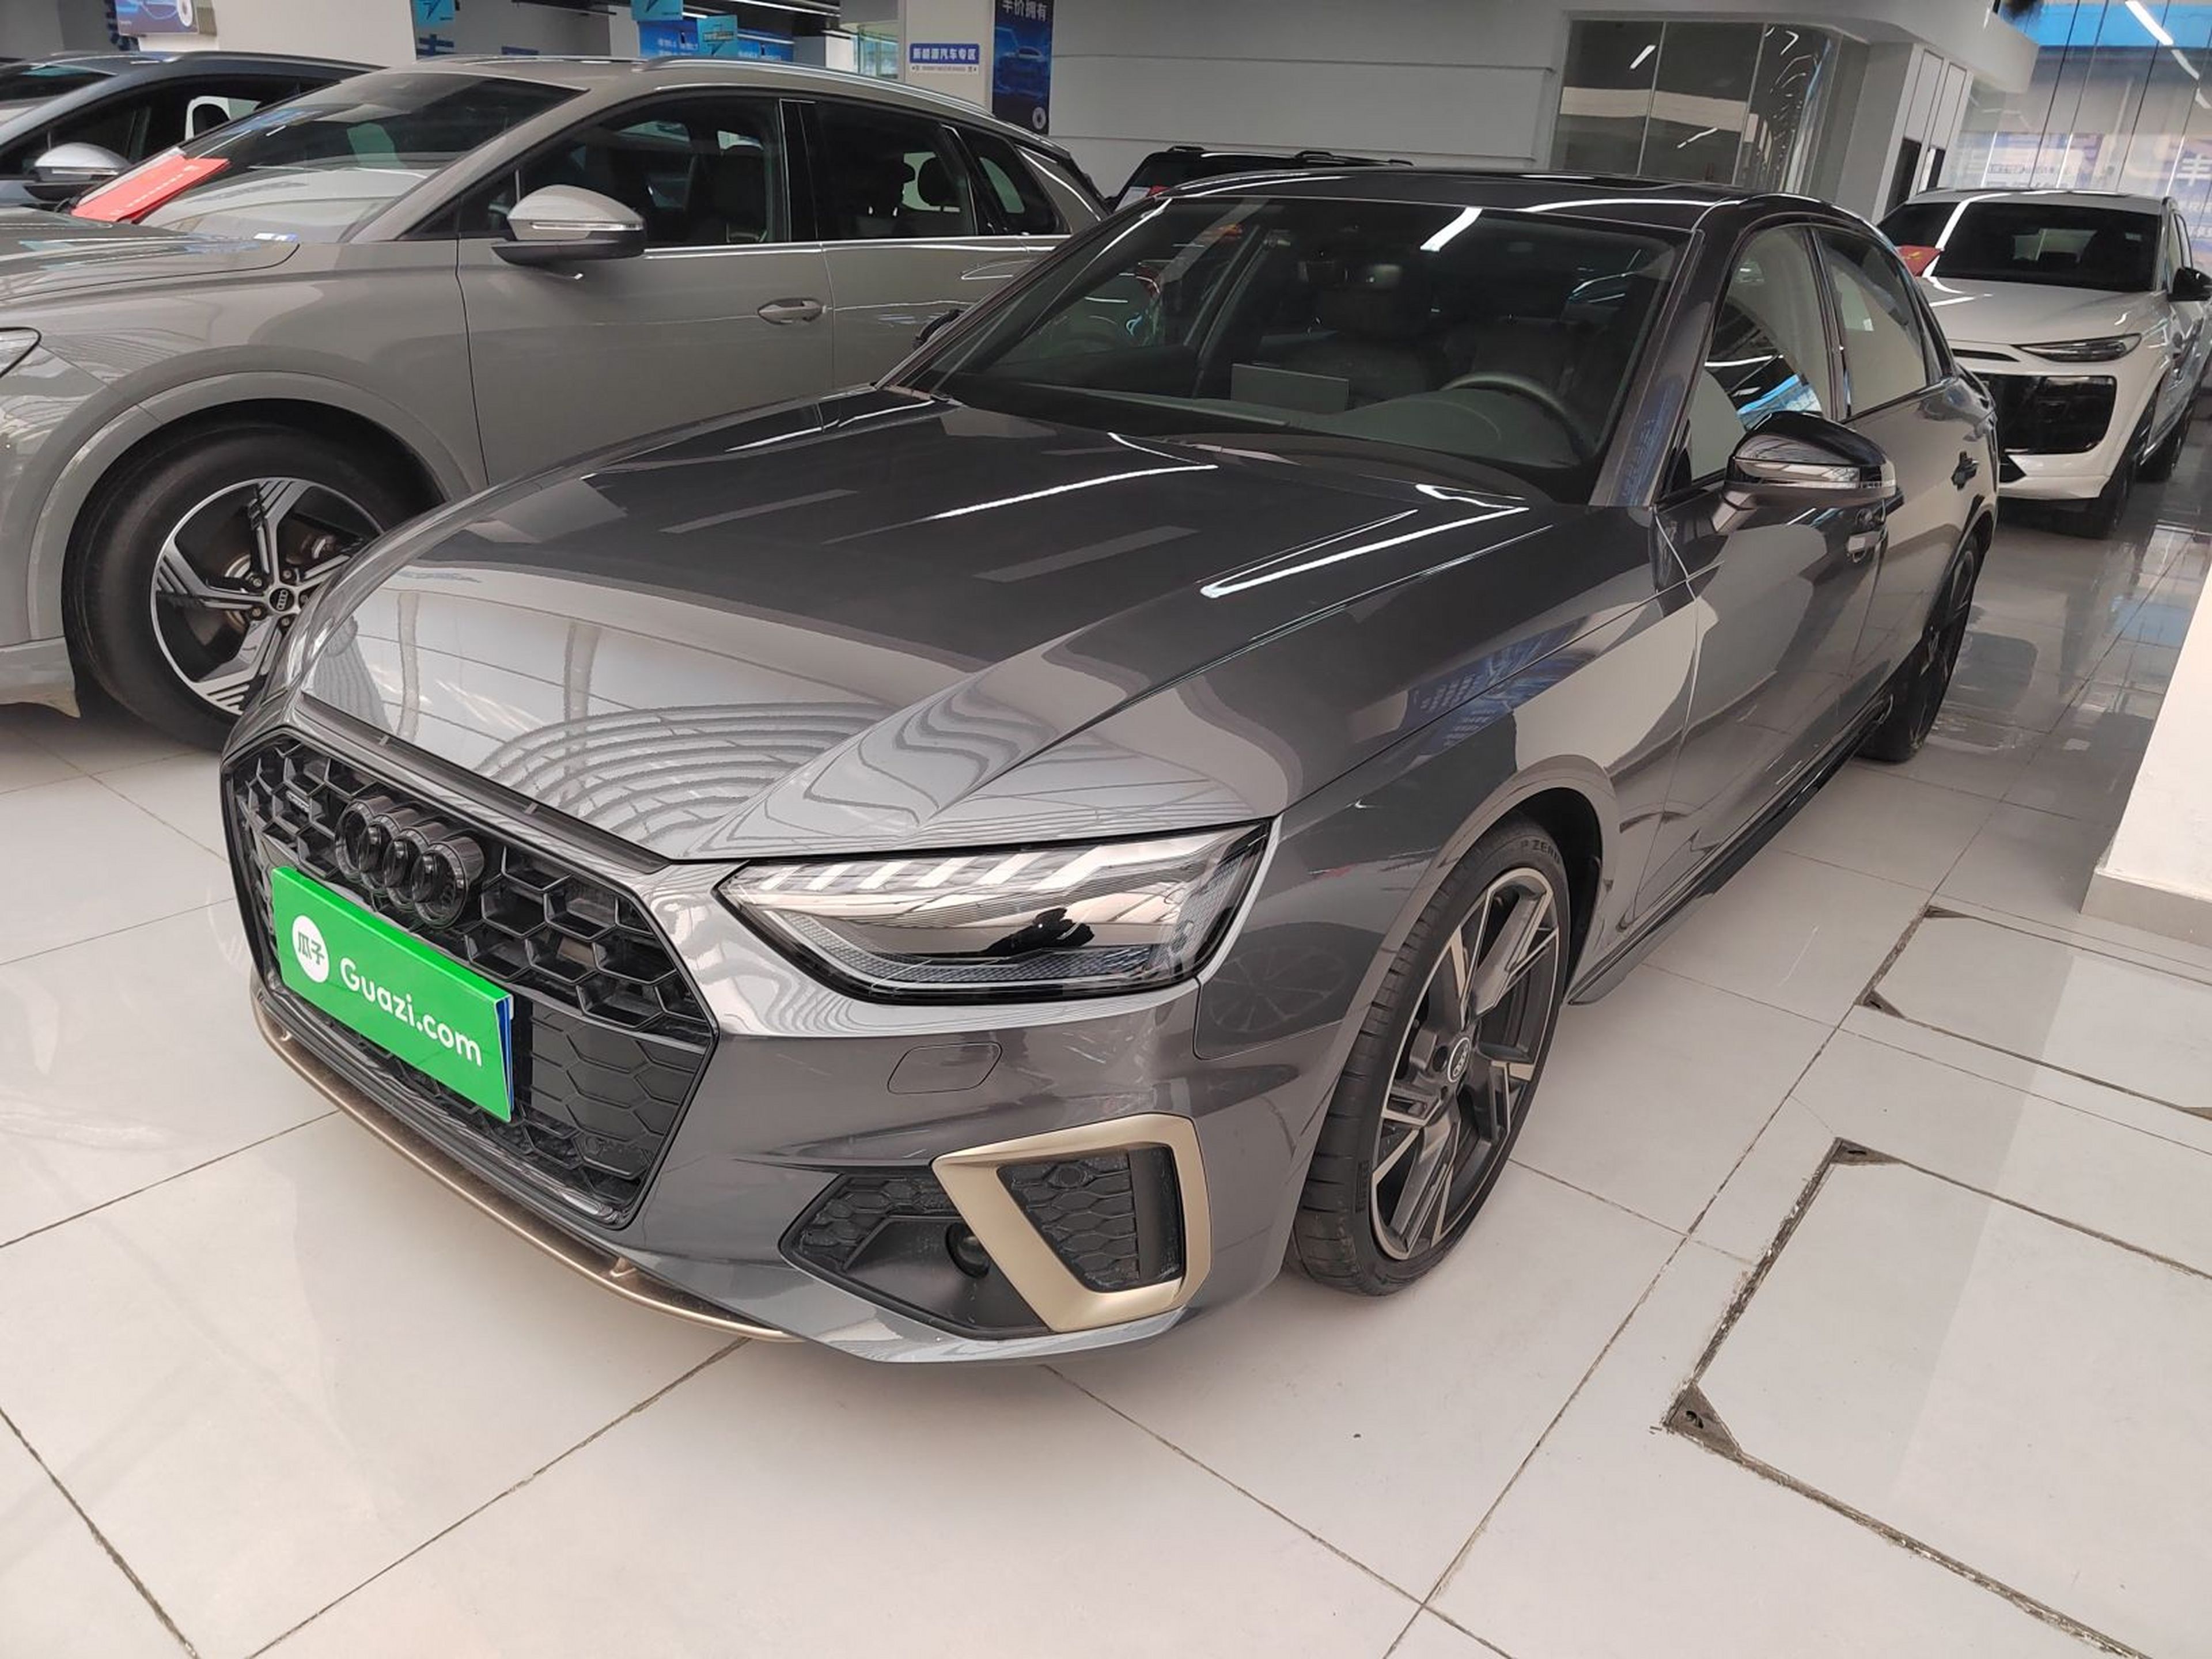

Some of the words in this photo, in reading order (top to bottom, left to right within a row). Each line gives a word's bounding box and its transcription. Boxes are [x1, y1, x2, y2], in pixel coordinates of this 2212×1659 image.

[913, 48, 976, 60] 新能源汽车专区
[298, 931, 325, 966] 瓜子
[340, 957, 482, 1068] Guazi.com
